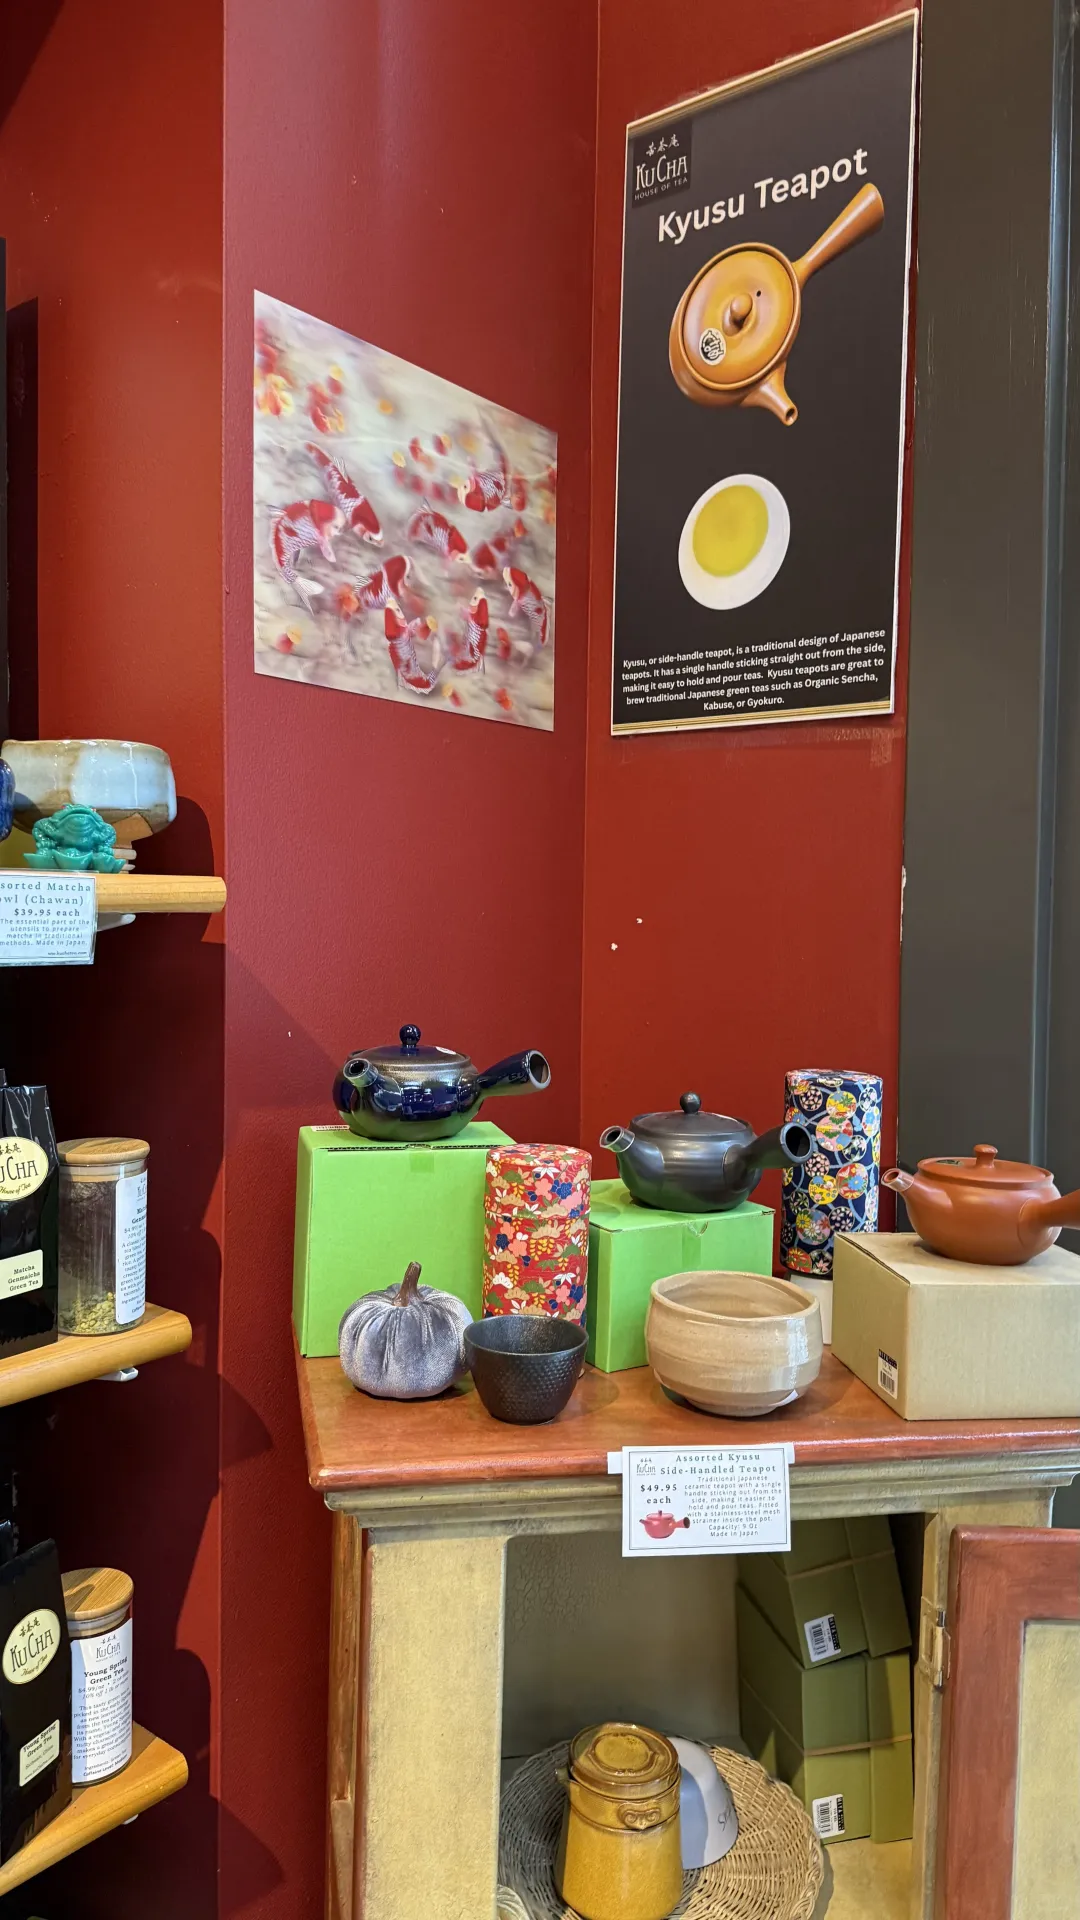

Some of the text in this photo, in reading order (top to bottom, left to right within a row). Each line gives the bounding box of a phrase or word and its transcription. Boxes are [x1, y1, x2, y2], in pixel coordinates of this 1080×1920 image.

[634, 177, 688, 200] HOUSE OF TEA
[658, 148, 868, 245] Kyusu Teapot
[623, 659, 647, 669] Kyusu,
[648, 657, 657, 665] or
[658, 650, 704, 664] side-handle
[705, 647, 734, 659] teapot,
[736, 645, 743, 654] is
[751, 638, 797, 653] traditional
[798, 636, 828, 647] design
[829, 633, 840, 643] of
[841, 629, 886, 643] Japanese
[622, 669, 652, 681] teapots.
[653, 669, 660, 677] It
[661, 667, 675, 676] has
[682, 664, 705, 675] single
[706, 660, 734, 672] handle
[736, 656, 768, 668] sticking
[769, 652, 803, 665] straight
[805, 650, 821, 660] out
[822, 648, 844, 658] from
[846, 645, 862, 655] the
[863, 643, 886, 653] side,
[622, 658, 884, 693] making it easy to hold and pour teas. Kyusu teapots are great to
[626, 672, 878, 705] brew traditional Japanese green teas such as Organic Sencha,
[703, 695, 785, 711] Kabuse, or Gyokuro.
[47, 882, 91, 891] Matcha
[25, 894, 84, 906] (Chawan)
[14, 908, 51, 916] $39.95
[14, 1266, 35, 1274] Matcha
[8, 1272, 40, 1284] Genmaicha
[10, 1283, 26, 1291] Green
[676, 1453, 760, 1462] Assorted Kyusu
[660, 1465, 776, 1475] Side-Handled Teapot
[640, 1484, 677, 1492] $49.95
[647, 1496, 671, 1504] each
[711, 1509, 761, 1517] stainless-steel
[84, 1667, 107, 1677] Young
[110, 1656, 127, 1670] Spring
[90, 1674, 112, 1684] Green
[114, 1667, 124, 1676] Tea
[23, 1723, 56, 1752] Young Spring
[27, 1735, 52, 1757] Green Tea
